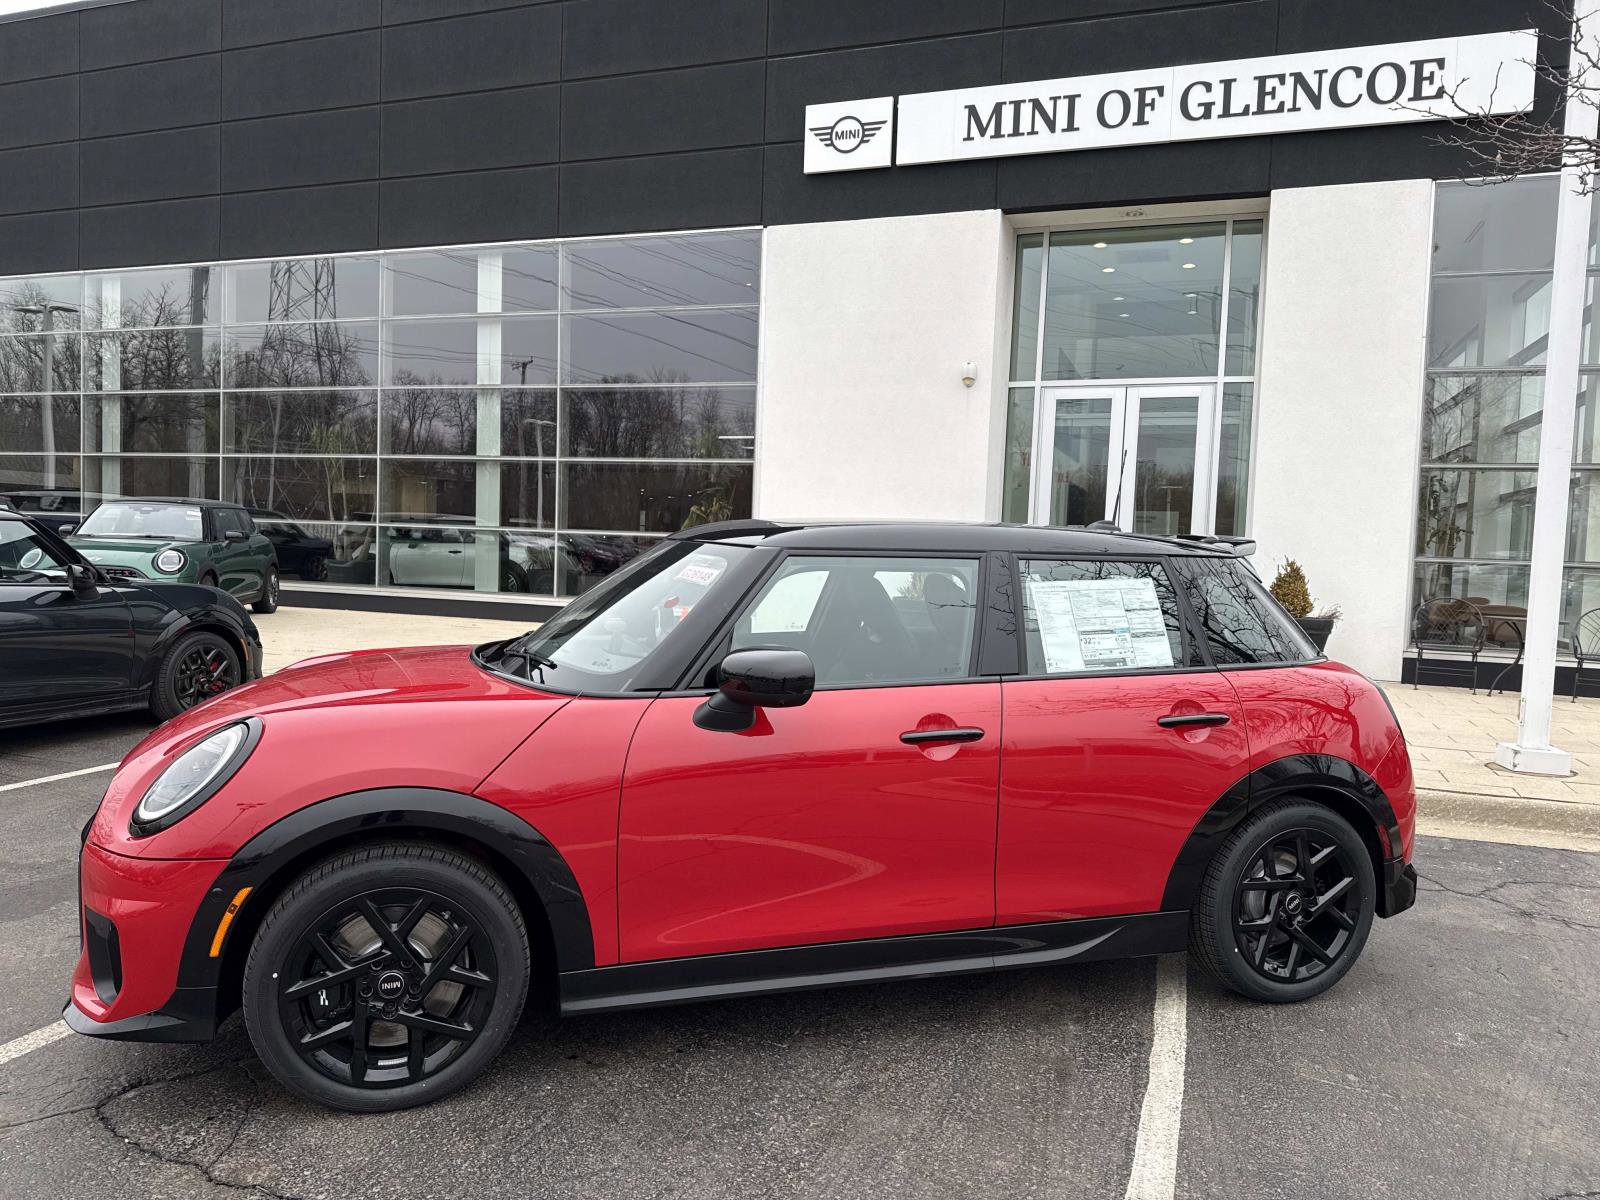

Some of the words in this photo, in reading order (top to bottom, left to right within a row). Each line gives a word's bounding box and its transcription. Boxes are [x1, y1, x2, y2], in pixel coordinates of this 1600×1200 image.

[962, 93, 1082, 141] MINI
[1096, 84, 1165, 129] OF
[1179, 57, 1446, 122] GLENCOE
[834, 129, 860, 140] MINI
[381, 981, 401, 990] MINI
